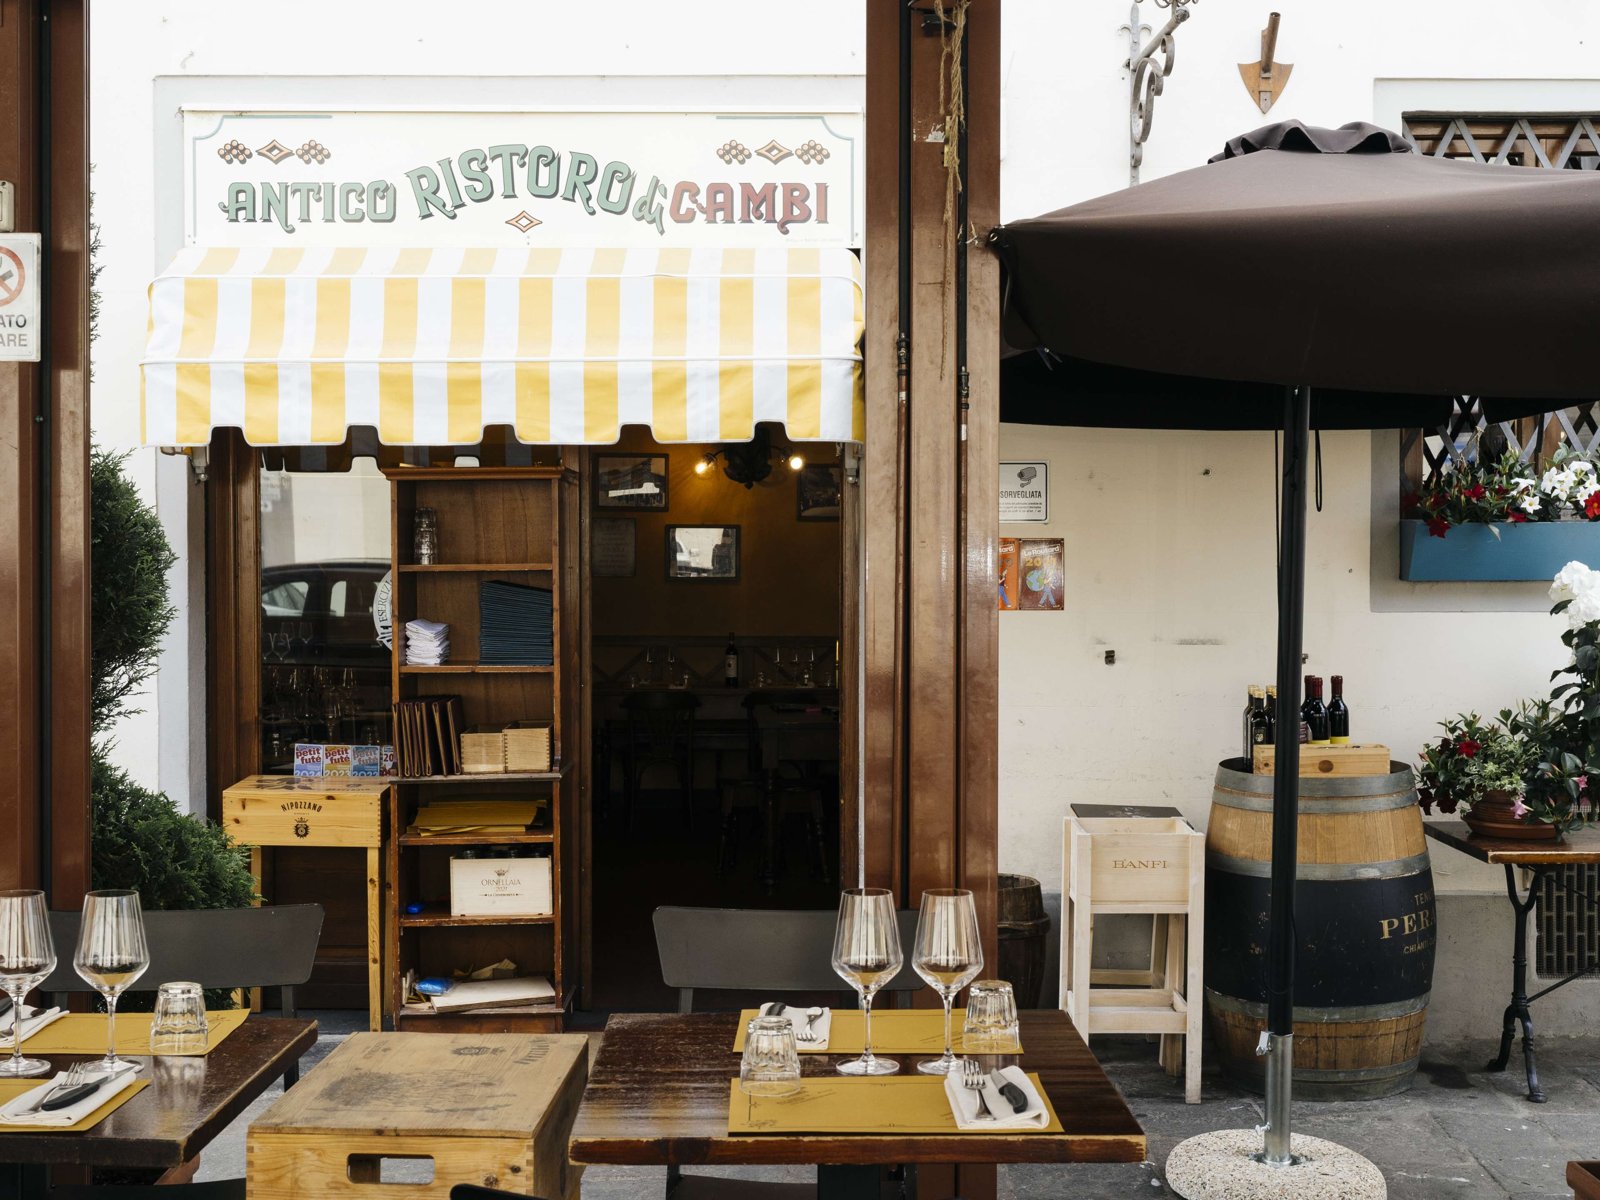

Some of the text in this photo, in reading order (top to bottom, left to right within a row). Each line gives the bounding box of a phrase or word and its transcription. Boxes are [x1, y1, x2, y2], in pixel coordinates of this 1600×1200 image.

[218, 180, 397, 234] ANTICO
[404, 143, 637, 220] RISTORO
[669, 181, 830, 235] CAMBI
[999, 490, 1042, 499] SORVEGLIATA
[295, 747, 321, 760] petit
[325, 747, 349, 760] petit
[281, 801, 323, 813] NIPOZZANO
[1112, 860, 1168, 869] BANFI
